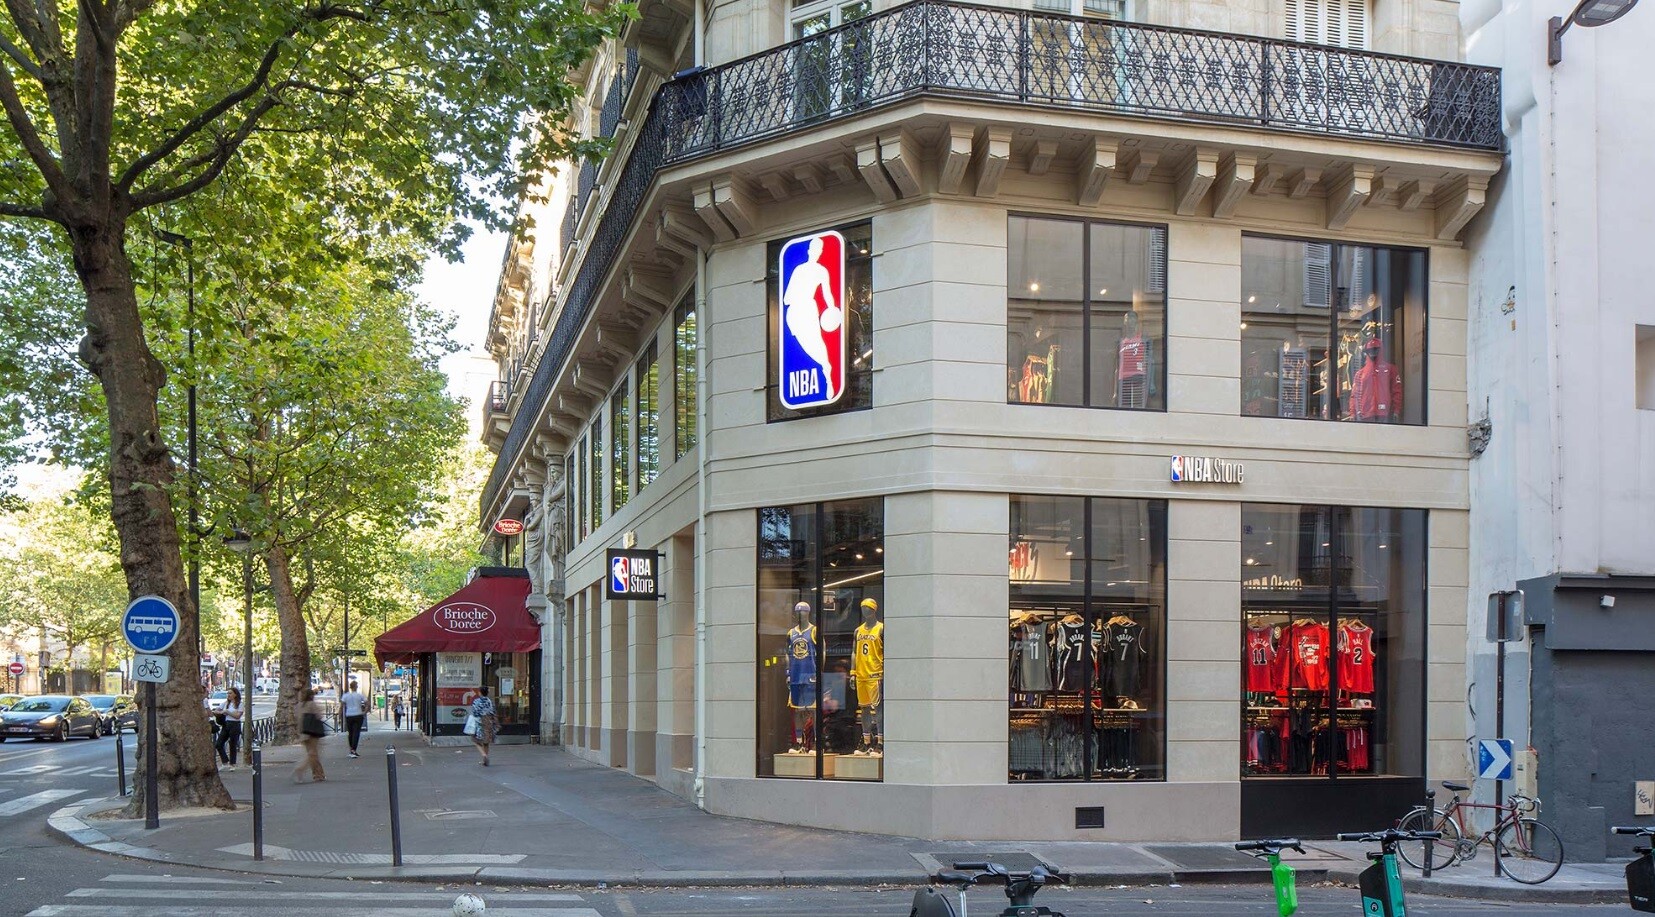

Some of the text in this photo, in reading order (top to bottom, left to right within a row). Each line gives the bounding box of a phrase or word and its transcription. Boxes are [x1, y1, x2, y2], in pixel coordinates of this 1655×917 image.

[789, 367, 820, 398] NBA
[1184, 456, 1244, 484] NBA Store
[498, 520, 520, 529] Brioche
[630, 557, 651, 576] NBA
[630, 575, 654, 593] Store
[443, 607, 488, 620] Brioche
[449, 618, 482, 629] Dorée
[862, 643, 869, 656] 6
[1029, 641, 1039, 660] 11
[1073, 642, 1082, 661] 7
[1120, 642, 1129, 661] 7
[1252, 647, 1268, 666] 11
[1353, 647, 1363, 665] 2
